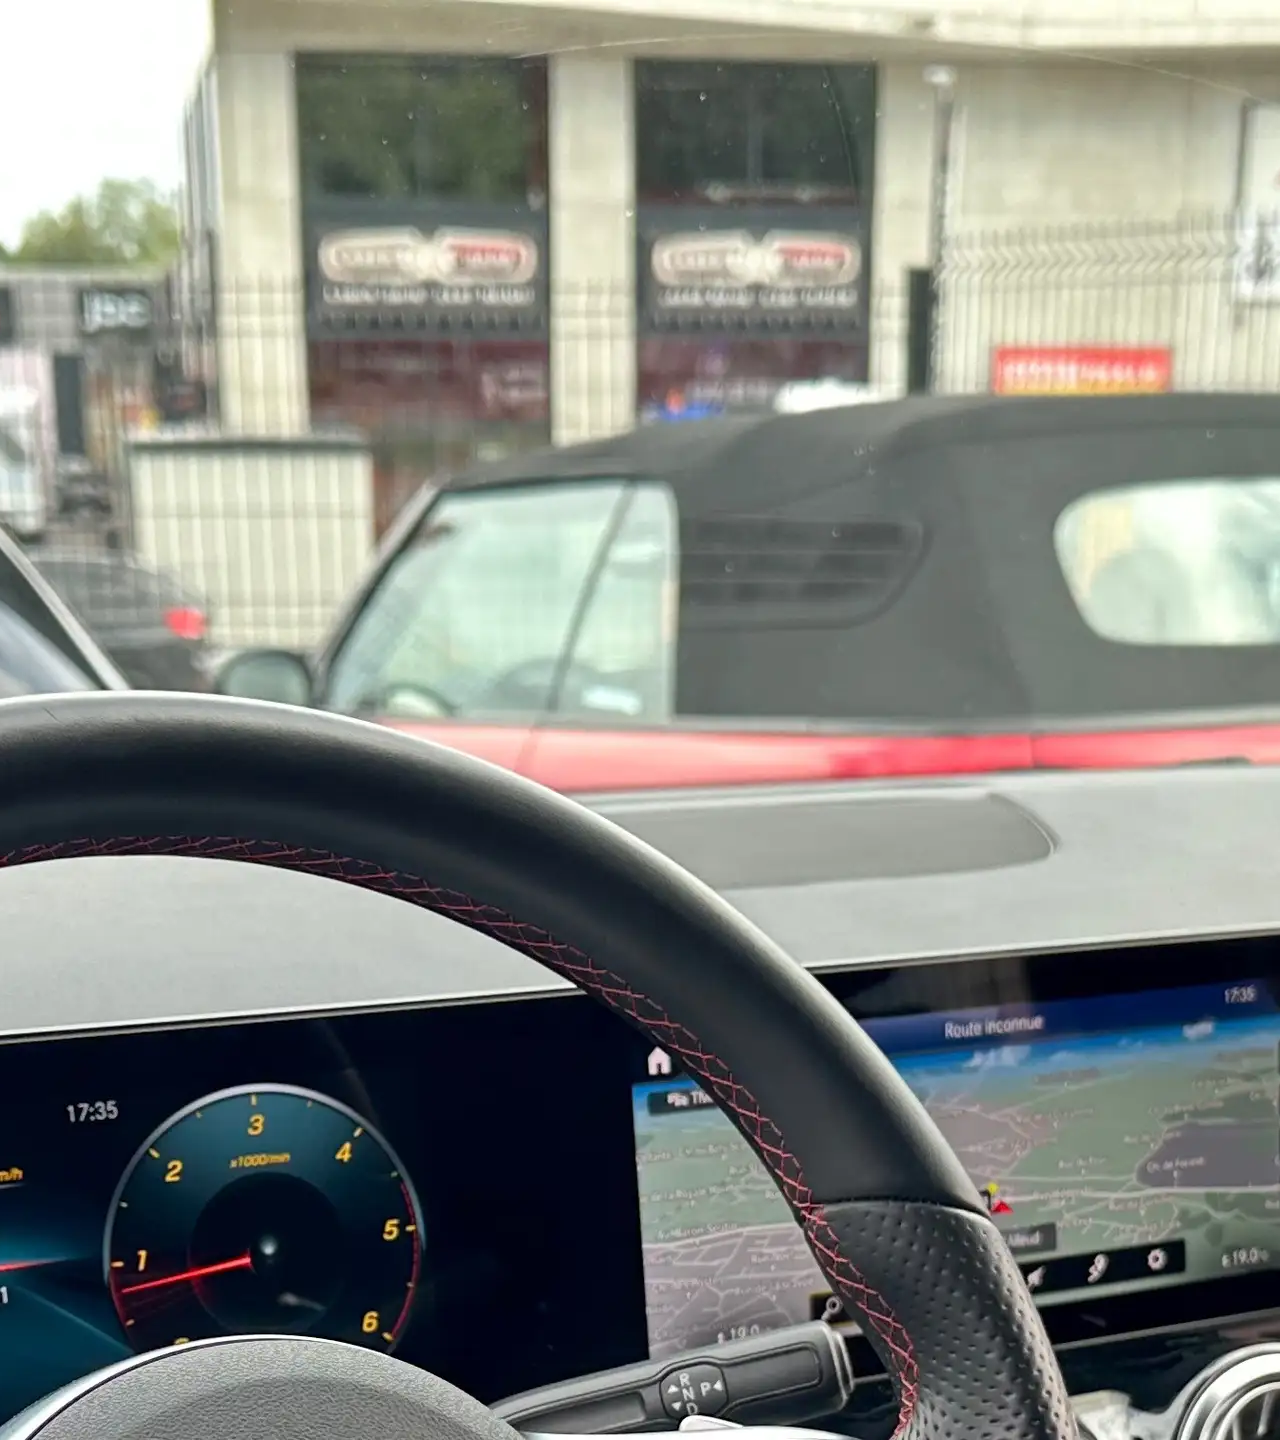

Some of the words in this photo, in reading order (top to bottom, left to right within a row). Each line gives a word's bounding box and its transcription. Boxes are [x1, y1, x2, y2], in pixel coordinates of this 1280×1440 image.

[944, 1019, 982, 1039] Route
[984, 1014, 1044, 1034] inconnue
[66, 1100, 119, 1123] 17:35
[247, 1114, 264, 1136] 3
[335, 1142, 352, 1163] 4
[164, 1160, 183, 1183] 2
[382, 1218, 400, 1241] 5
[136, 1249, 148, 1271] 1
[361, 1311, 379, 1334] 6
[679, 1373, 690, 1387] R
[700, 1382, 711, 1397] P
[682, 1387, 696, 1401] N
[686, 1402, 699, 1416] D
